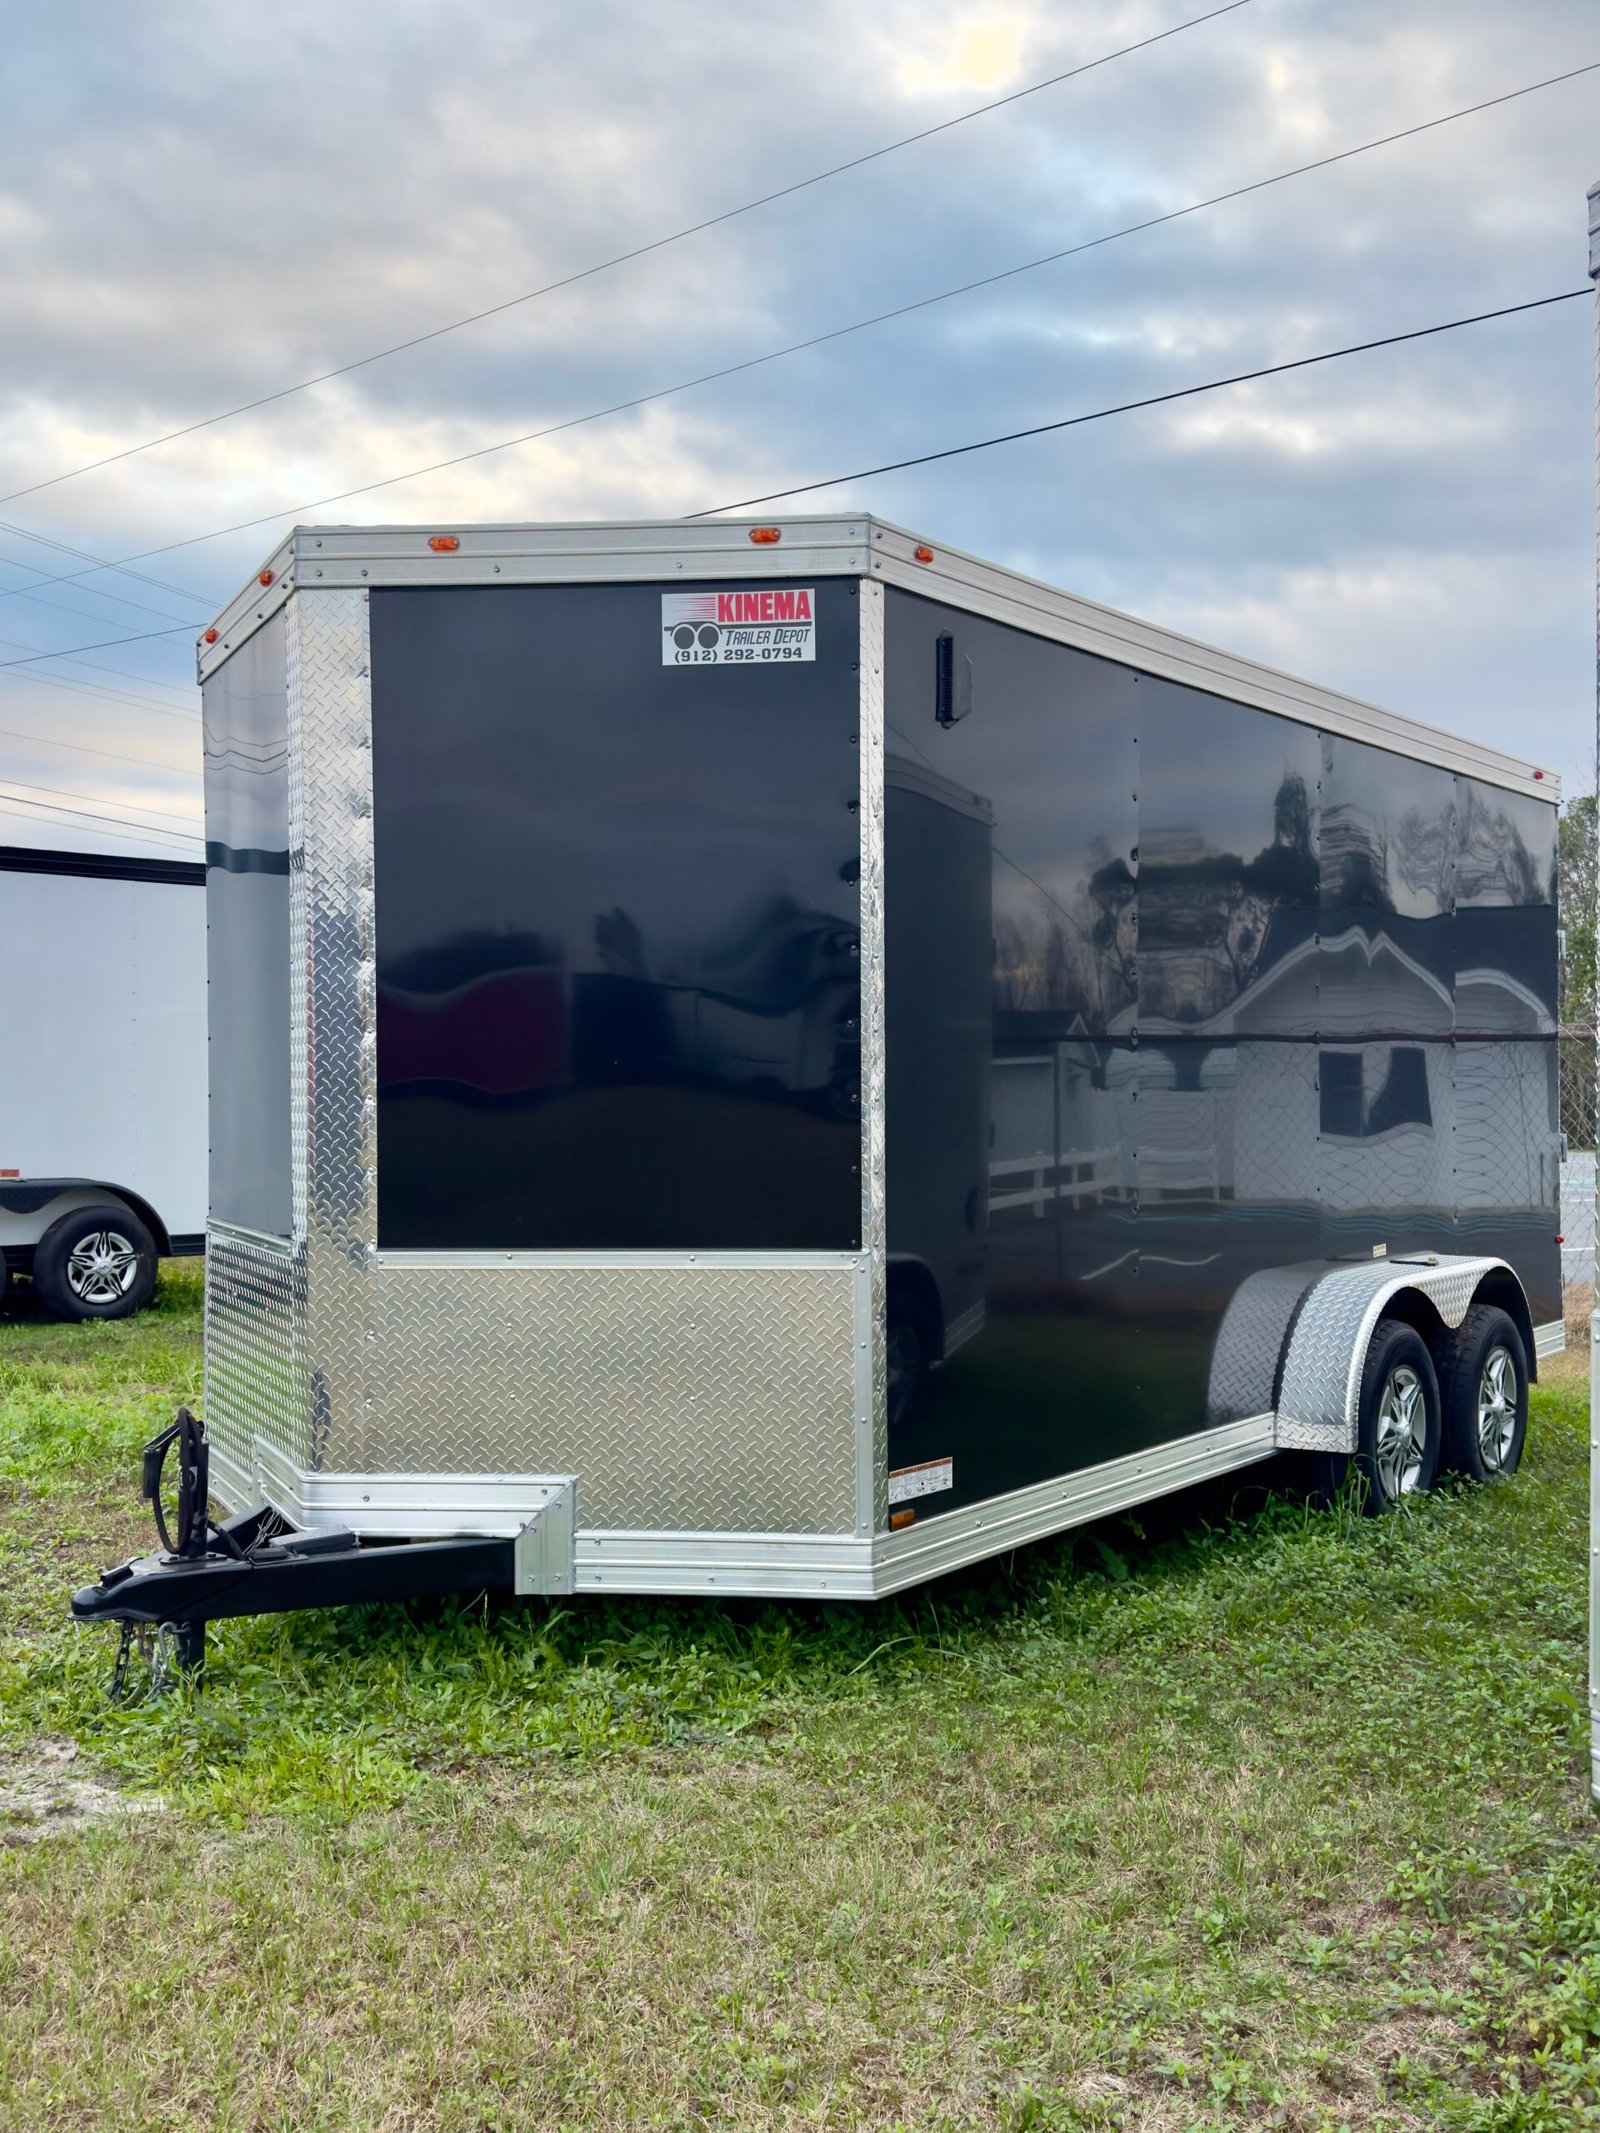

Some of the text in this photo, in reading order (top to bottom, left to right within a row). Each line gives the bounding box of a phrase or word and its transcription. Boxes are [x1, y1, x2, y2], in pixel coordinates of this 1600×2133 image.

[717, 590, 812, 623] KINEMA
[725, 628, 811, 646] TRAILER DEPOT
[674, 647, 803, 663] (912) 292-0794
